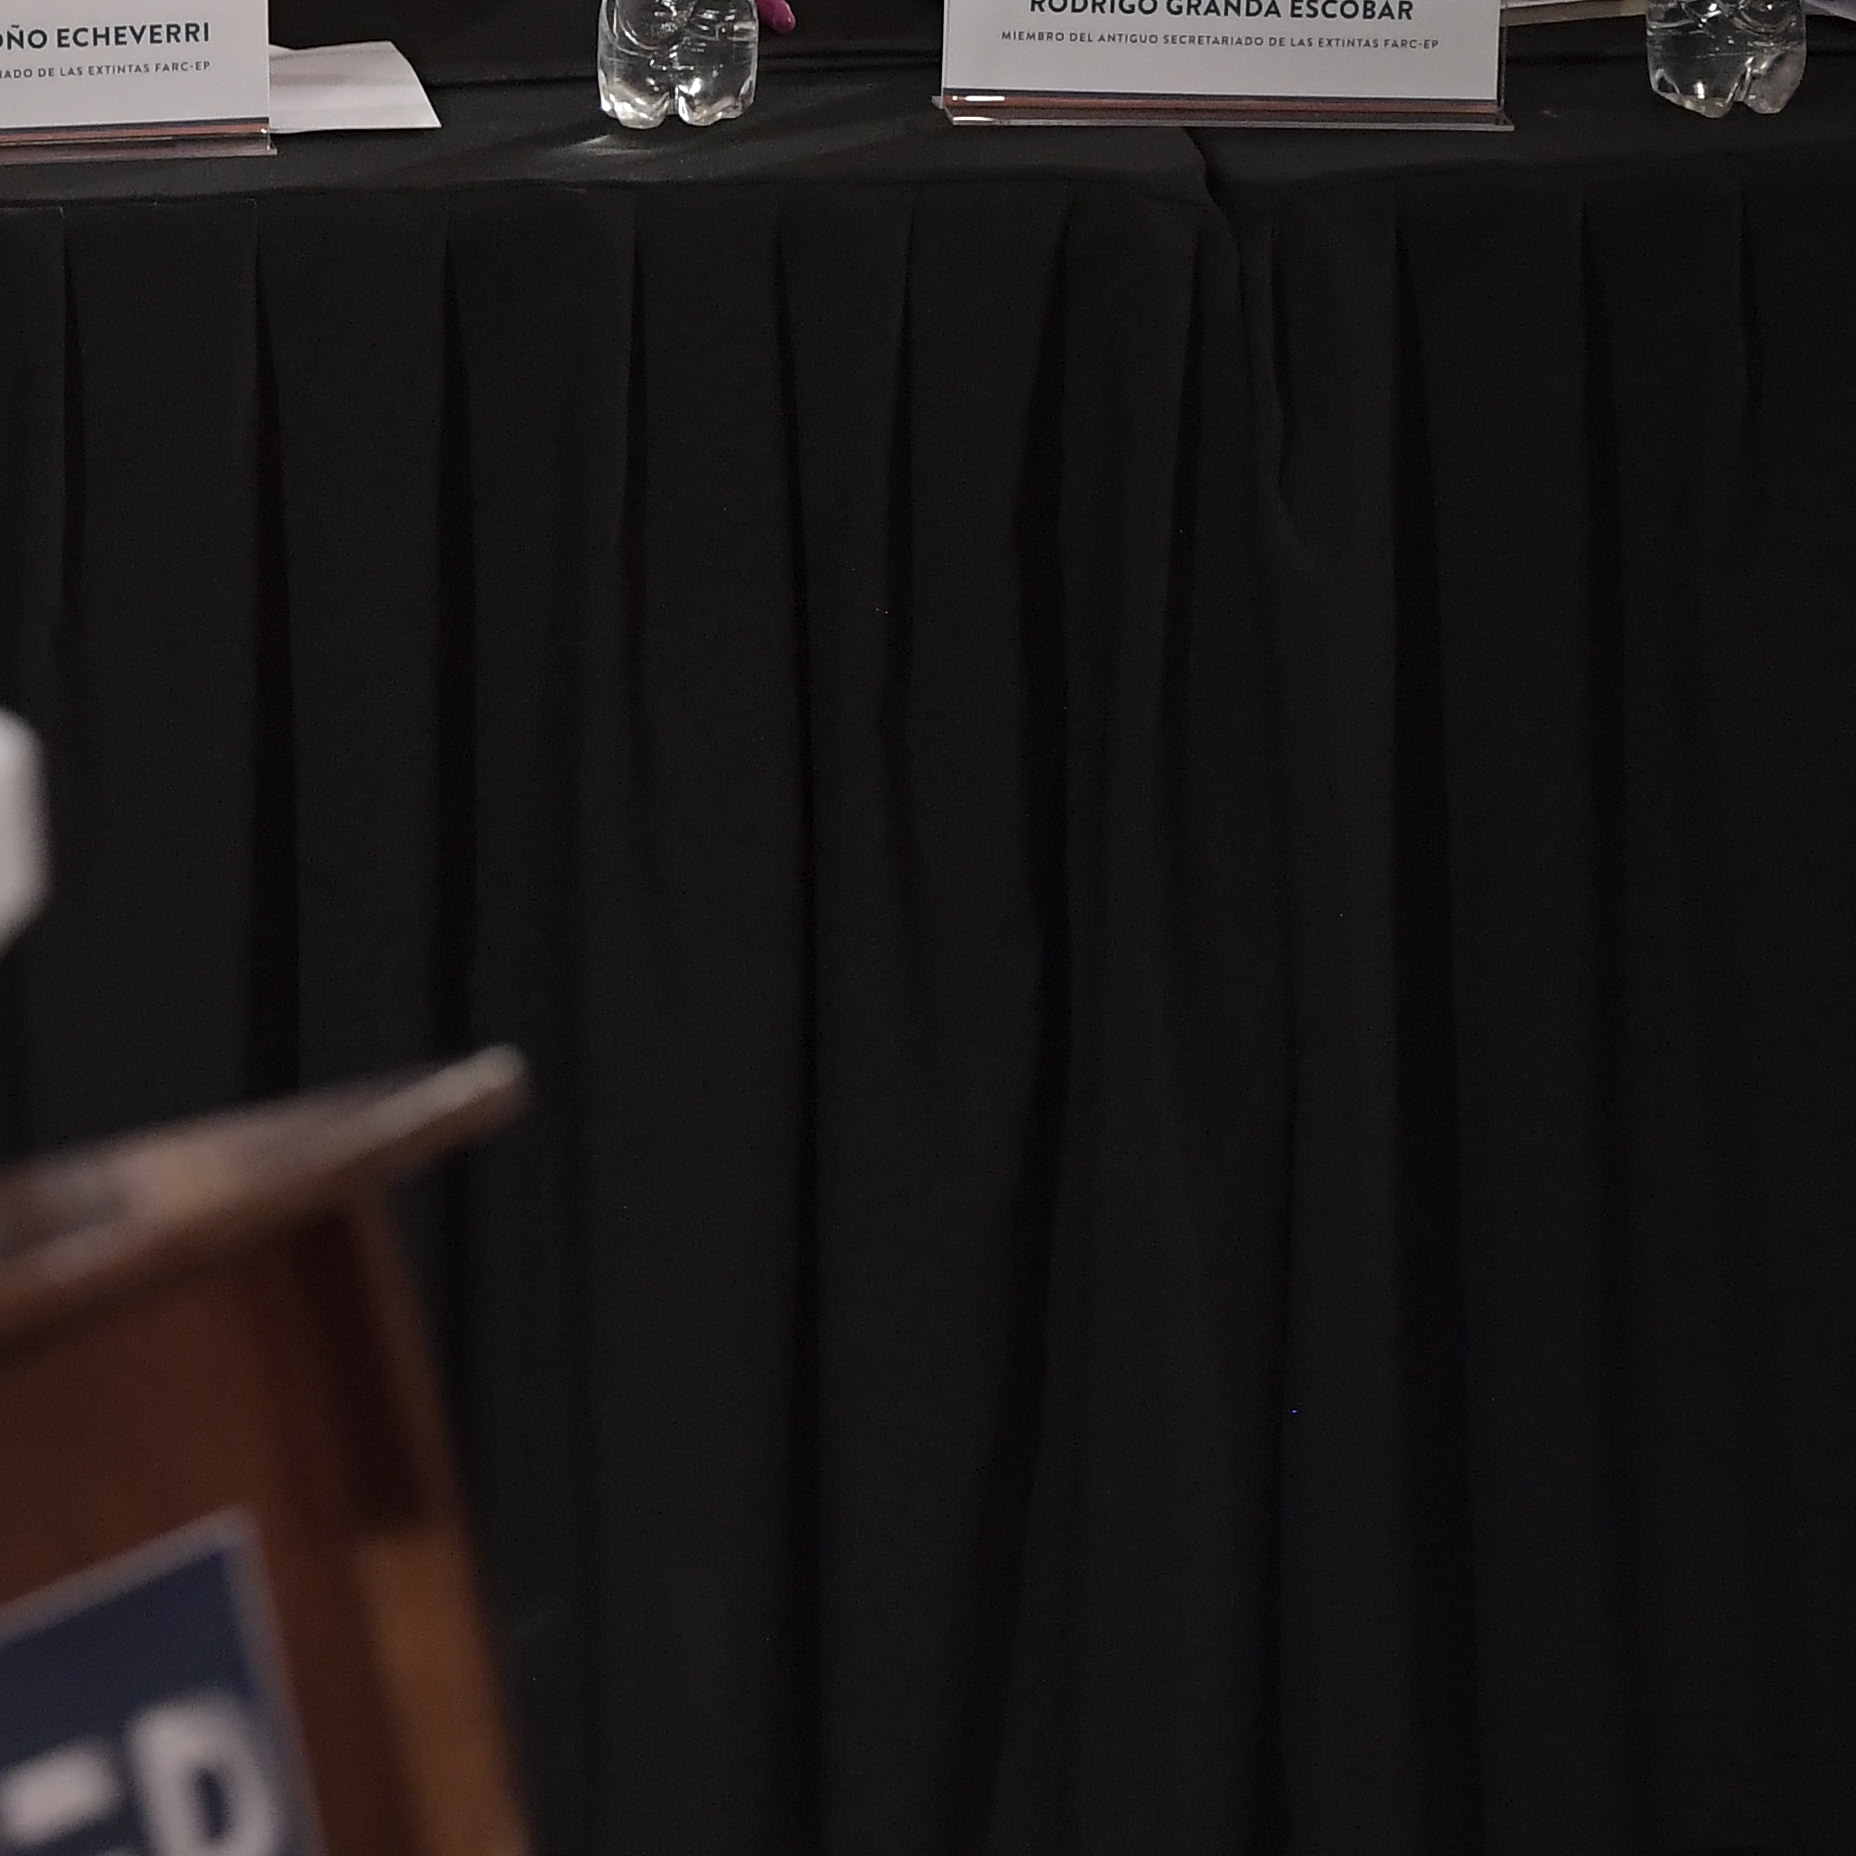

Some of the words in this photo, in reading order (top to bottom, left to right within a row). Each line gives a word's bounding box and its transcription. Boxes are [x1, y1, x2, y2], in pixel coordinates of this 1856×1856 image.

[56, 21, 209, 48] ECHEVERRI
[1000, 29, 1065, 42] MIEMBRO
[1068, 30, 1094, 43] DEL
[1096, 32, 1159, 44] ANTIGUO
[1162, 33, 1264, 47] SECRETARIADO
[1267, 35, 1286, 47] DE
[1289, 36, 1313, 48] LAS
[1317, 36, 1379, 48] EXTINTAS
[1383, 37, 1439, 50] FARC-EP
[37, 66, 55, 78] DE
[59, 65, 83, 77] LAS
[87, 62, 150, 76] EXTINTAS
[154, 59, 210, 73] FARC-EP
